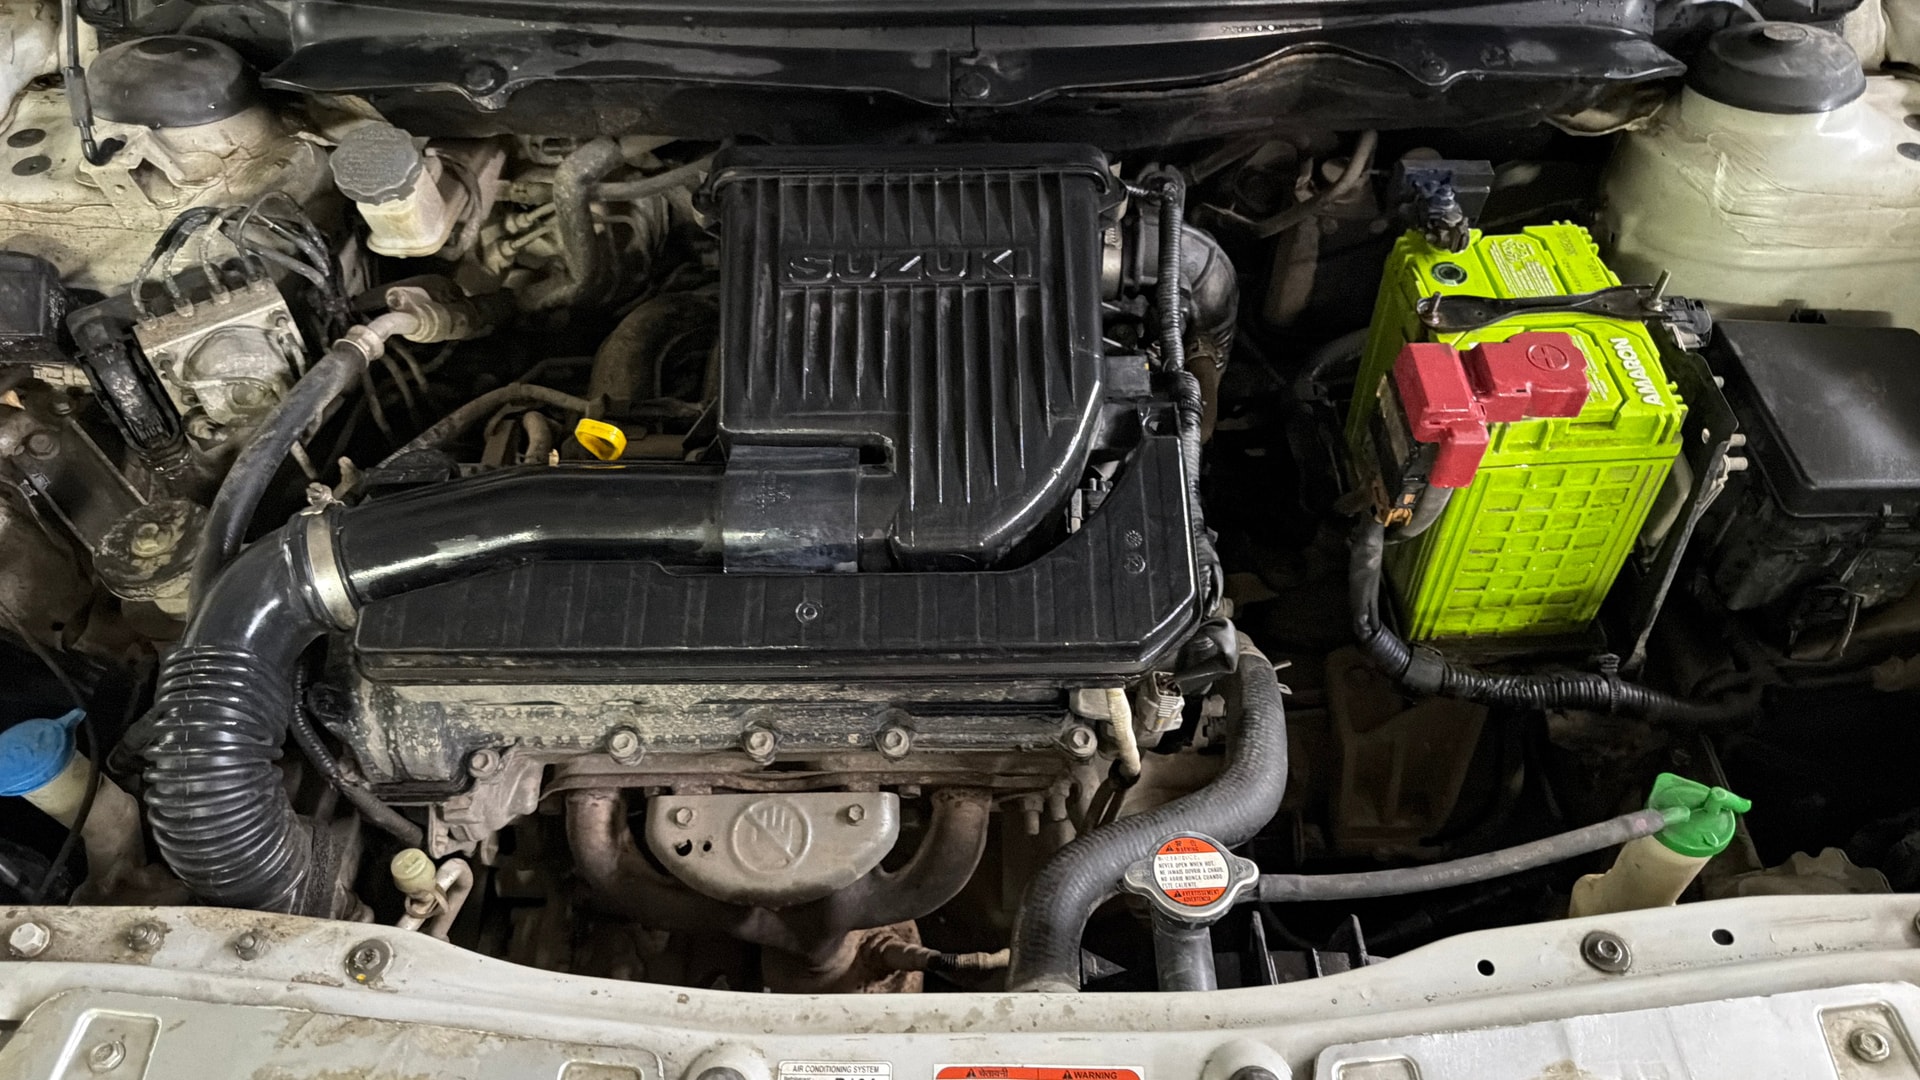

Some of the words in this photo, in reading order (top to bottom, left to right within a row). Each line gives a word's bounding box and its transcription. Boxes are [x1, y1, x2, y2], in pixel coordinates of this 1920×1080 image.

[787, 249, 1033, 284] SUZUKI
[1609, 337, 1665, 407] AMARON
[793, 1065, 804, 1073] AIR
[805, 1065, 851, 1073] CONDITIONING
[853, 1065, 880, 1073] SYSTEM
[1073, 1071, 1118, 1080] WARNING
